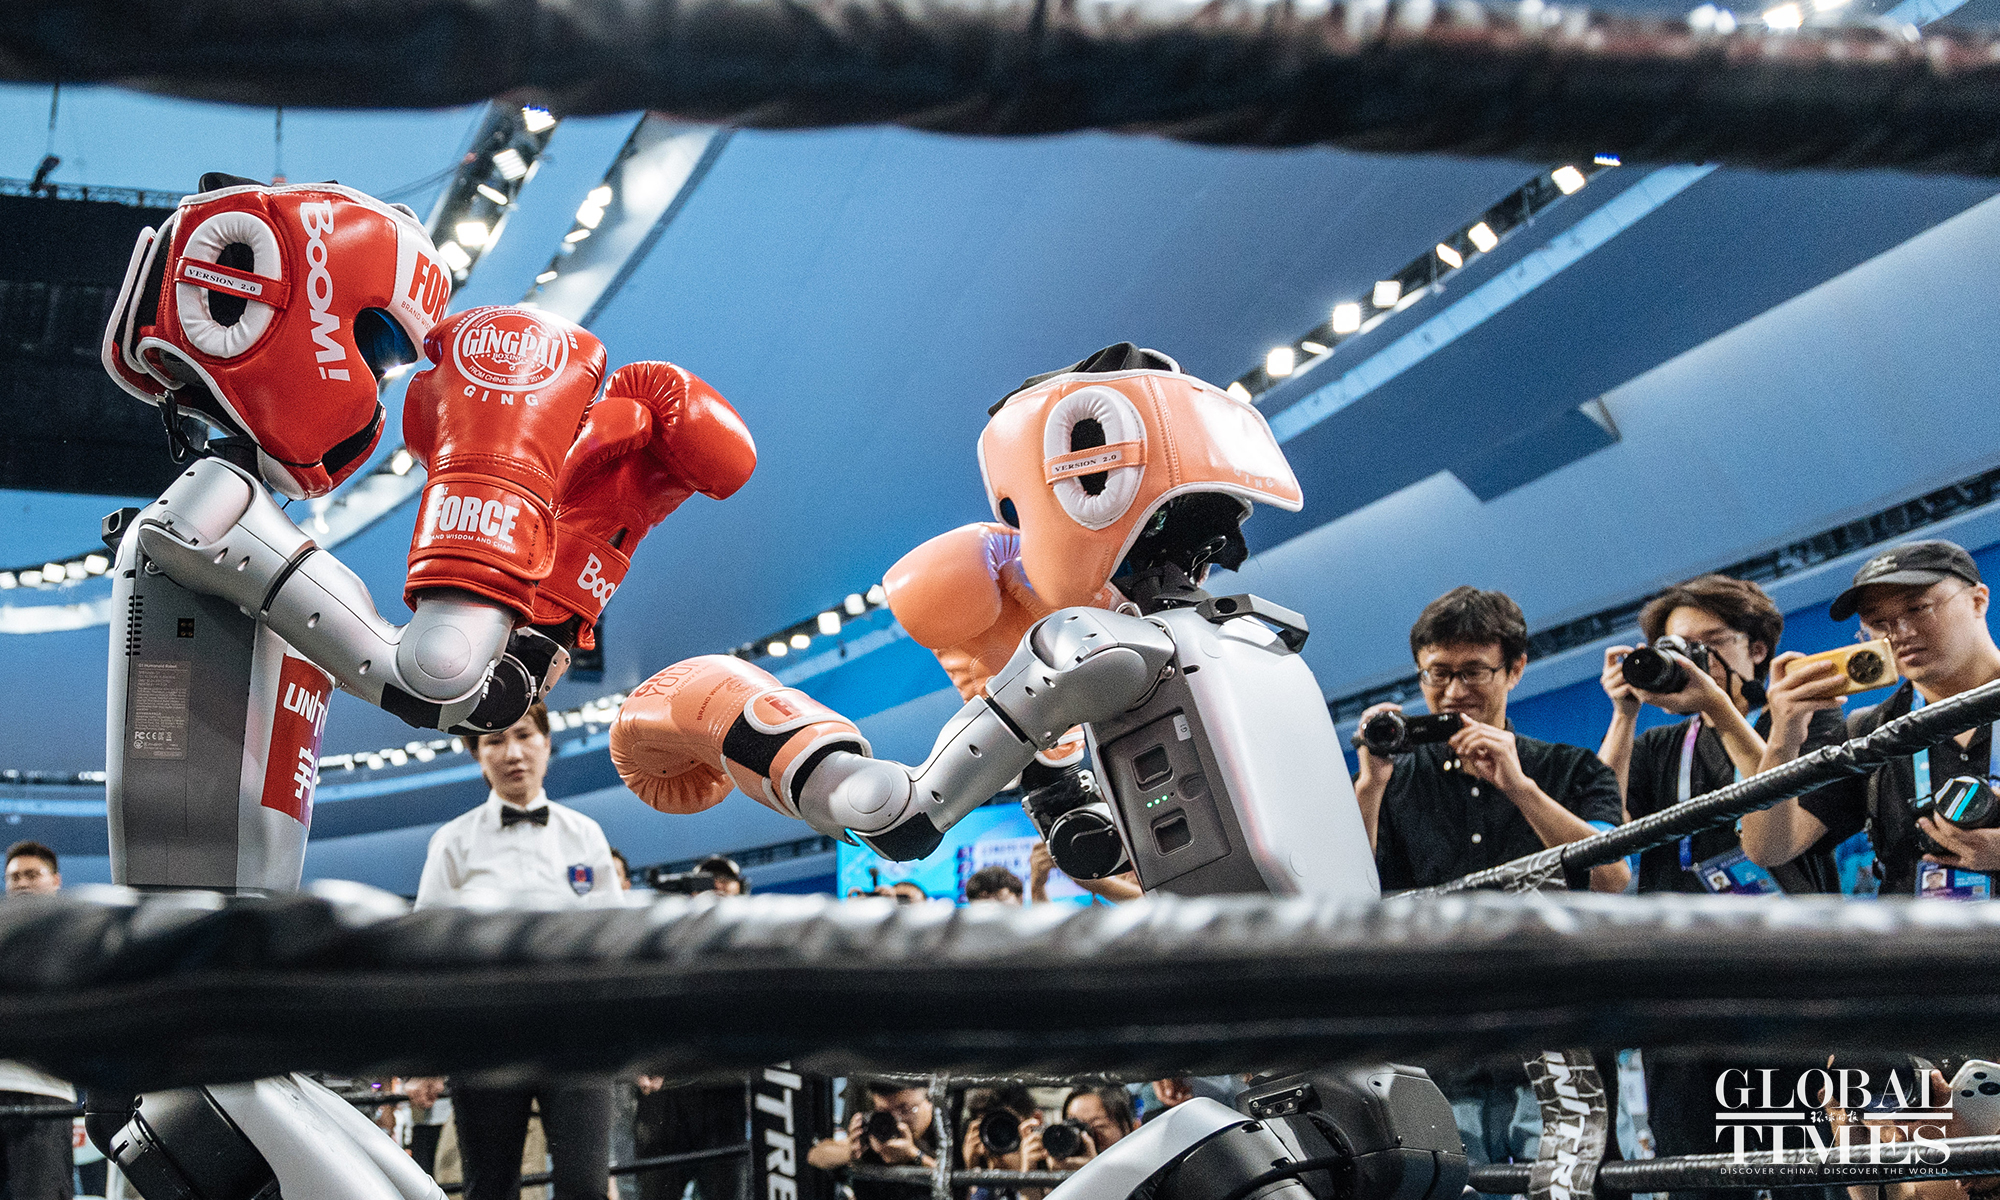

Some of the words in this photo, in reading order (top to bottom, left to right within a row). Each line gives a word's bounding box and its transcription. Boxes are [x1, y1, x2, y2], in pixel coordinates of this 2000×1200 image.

[189, 269, 234, 286] VERSION
[240, 283, 256, 292] 2.0
[401, 300, 421, 321] BRAND
[462, 327, 562, 372] GINGPAI
[492, 352, 526, 363] BOXING
[468, 365, 486, 379] FROM
[485, 374, 507, 384] CHINA
[529, 374, 545, 383] 2014
[463, 384, 539, 407] GING
[1055, 458, 1097, 472] VERSION
[1102, 454, 1117, 463] 2.0
[446, 533, 475, 542] WISDOM
[476, 536, 492, 545] AND
[492, 540, 517, 555] CHARM
[283, 682, 326, 737] UNIT
[696, 696, 711, 721] BRAND
